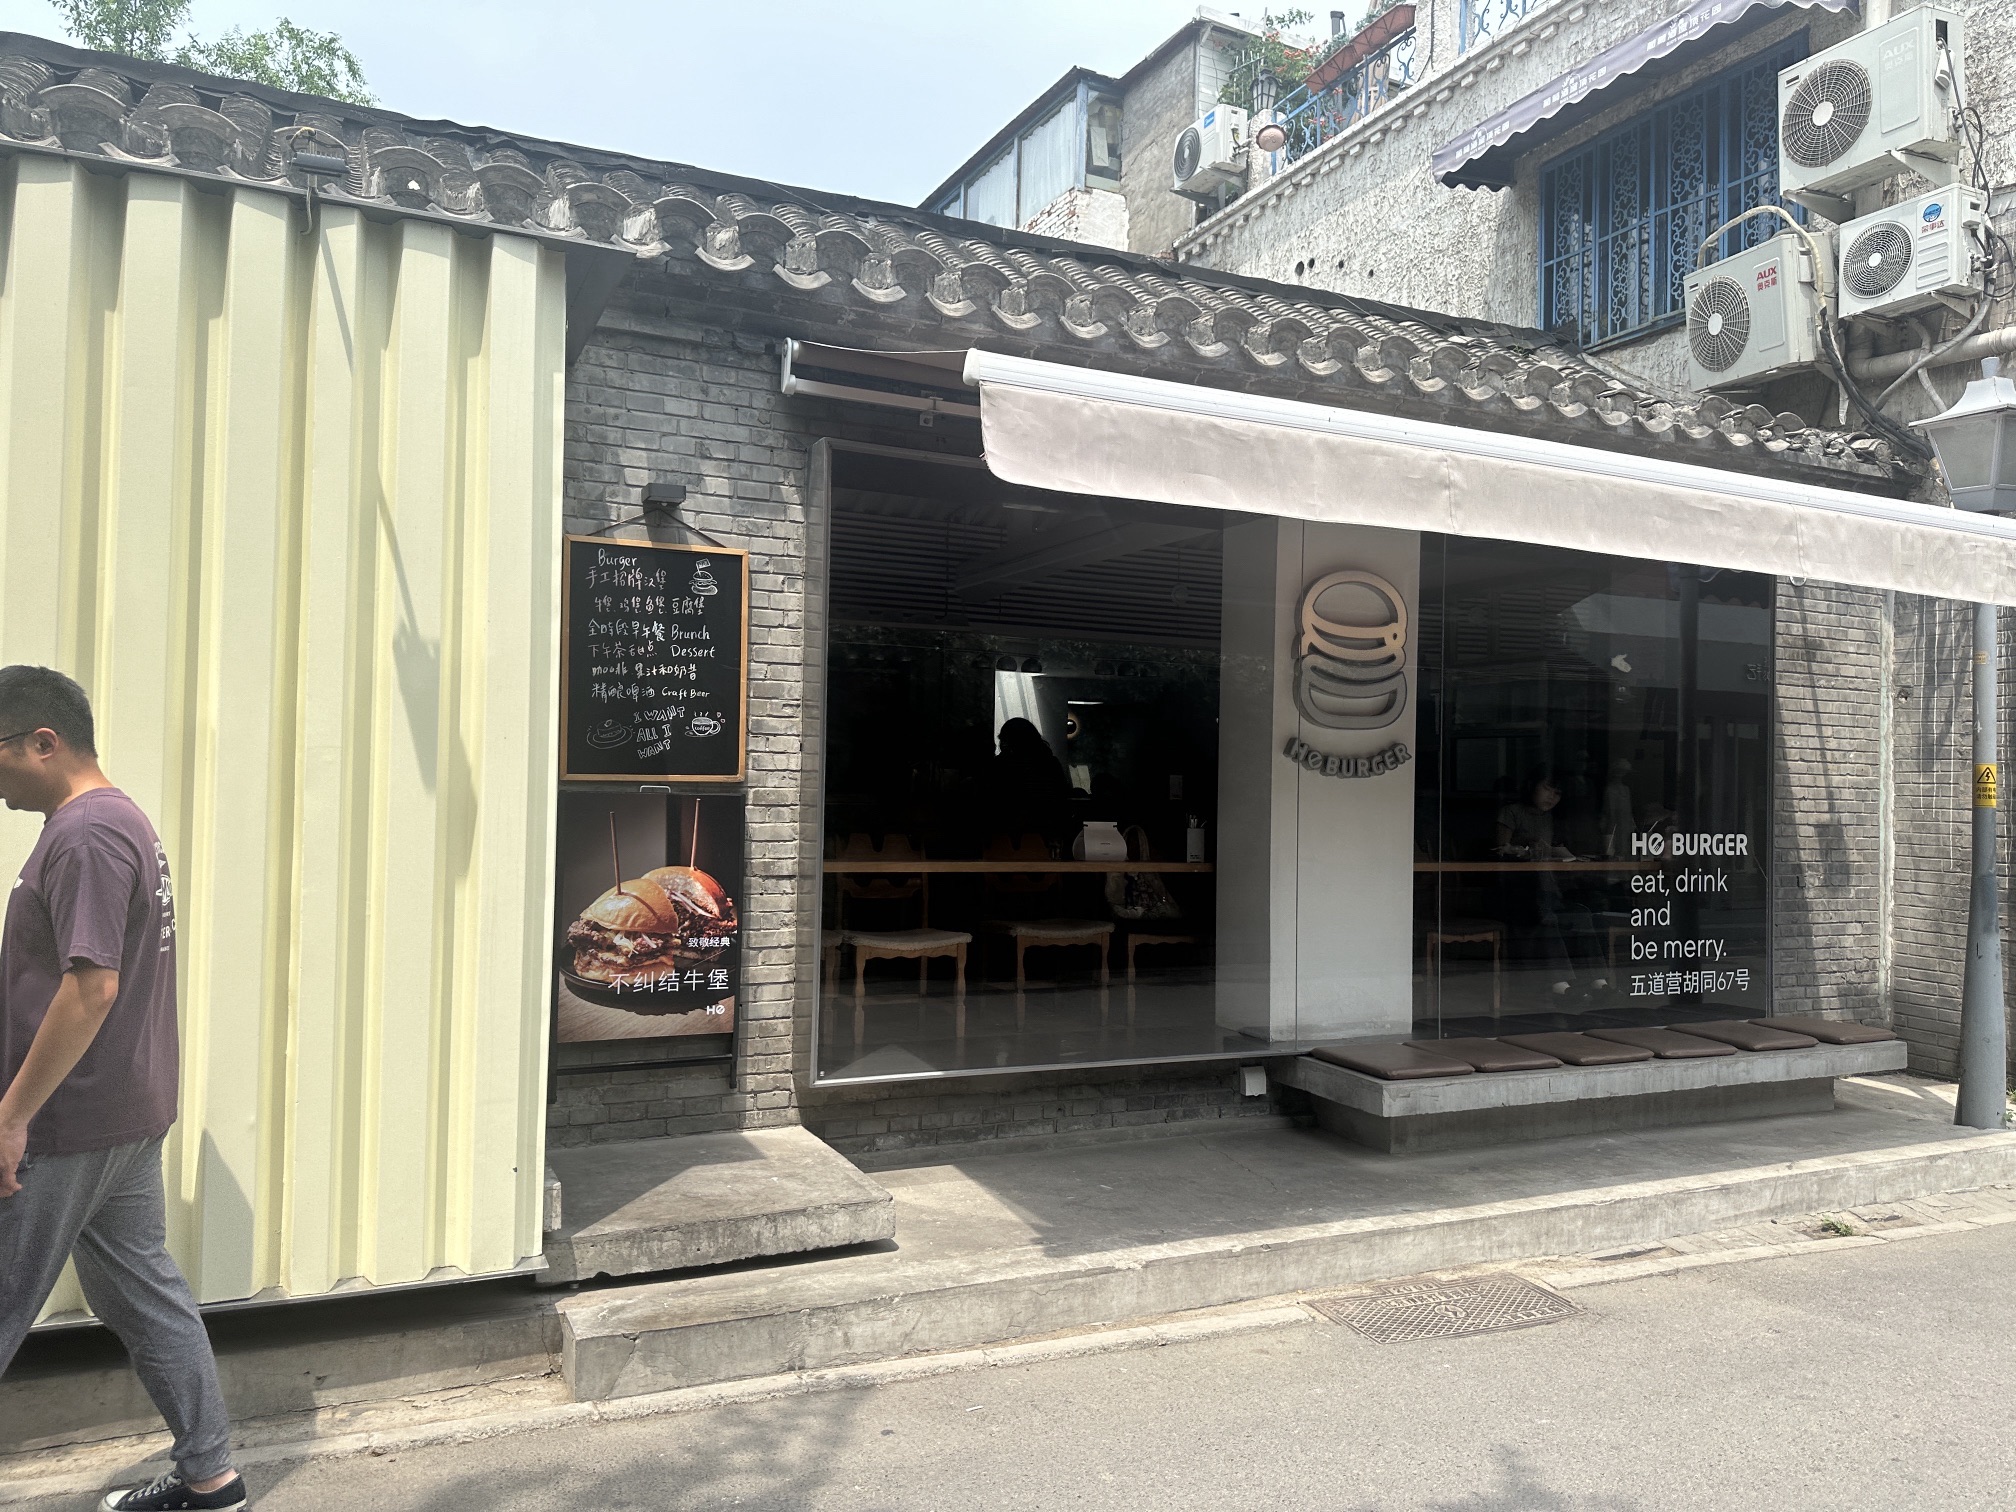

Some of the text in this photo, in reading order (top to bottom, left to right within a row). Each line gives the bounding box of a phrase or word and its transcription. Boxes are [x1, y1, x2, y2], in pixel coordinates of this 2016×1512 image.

[1756, 266, 1777, 281] AUX
[598, 548, 637, 570] Burger
[585, 566, 667, 590] 手工招牌汉堡
[671, 624, 710, 640] Brunch
[588, 640, 715, 658] 下午茶甜点 Dessert
[592, 682, 710, 703] 精酿啤酒 Craft Beer
[643, 705, 685, 721] WANT
[636, 724, 672, 743] ALL I
[637, 739, 671, 759] WANT
[1321, 743, 1412, 778] BURGER
[1672, 833, 1748, 856] BURGER
[1630, 867, 1728, 896] eat, drink
[1630, 901, 1671, 926] and
[688, 937, 730, 948] 致敬经典
[1631, 934, 1727, 961] be merry.
[608, 968, 729, 995] 不纠结牛堡
[1630, 968, 1750, 996] 五道营胡同67号
